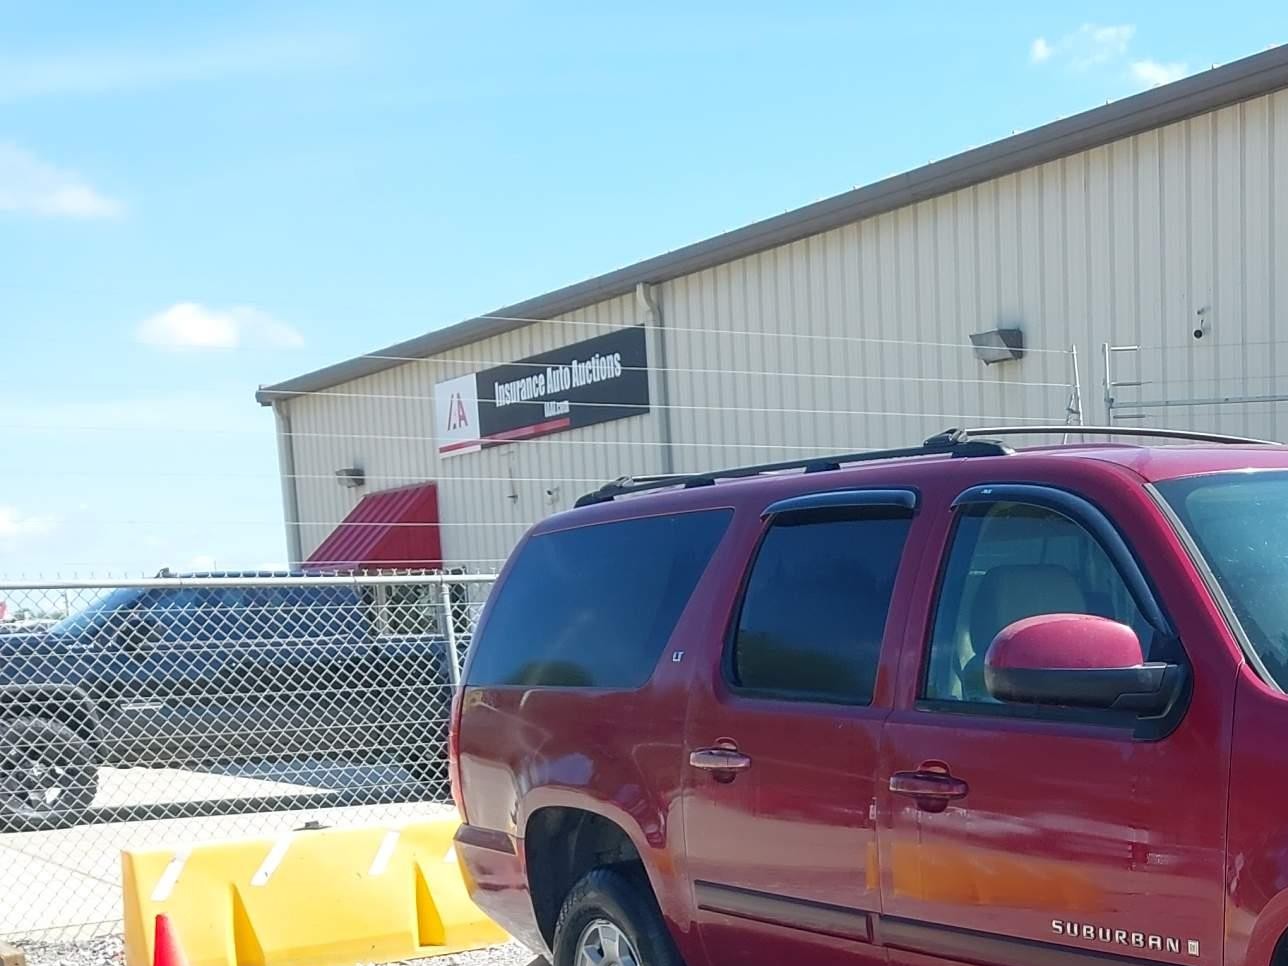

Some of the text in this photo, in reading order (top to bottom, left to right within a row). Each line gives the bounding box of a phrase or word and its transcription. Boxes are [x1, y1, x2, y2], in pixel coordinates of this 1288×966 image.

[495, 352, 622, 407] Insurance Auto Auctions
[672, 651, 685, 662] LT
[1051, 919, 1180, 954] SUBURBAN
